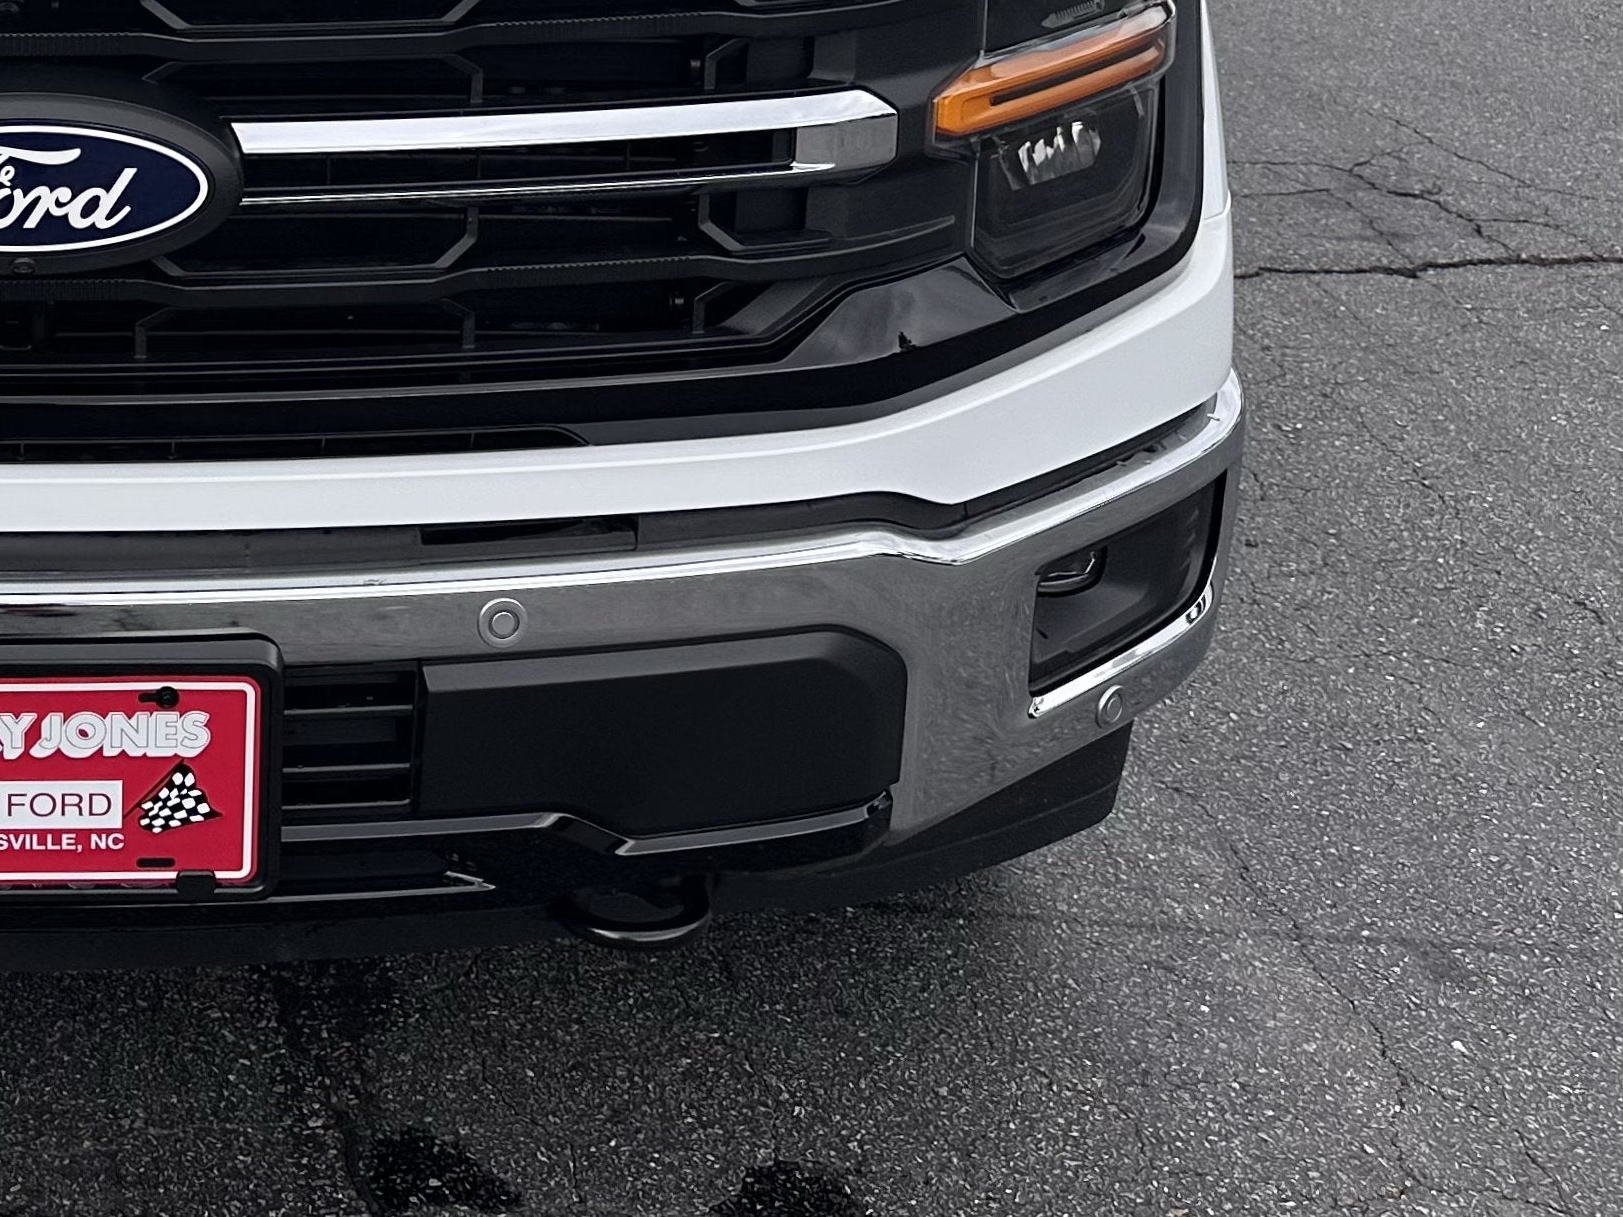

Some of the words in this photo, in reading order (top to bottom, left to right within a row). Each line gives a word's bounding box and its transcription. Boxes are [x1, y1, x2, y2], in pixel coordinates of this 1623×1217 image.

[29, 710, 211, 759] JONES
[7, 792, 113, 818] FORD
[90, 833, 126, 851] NC
